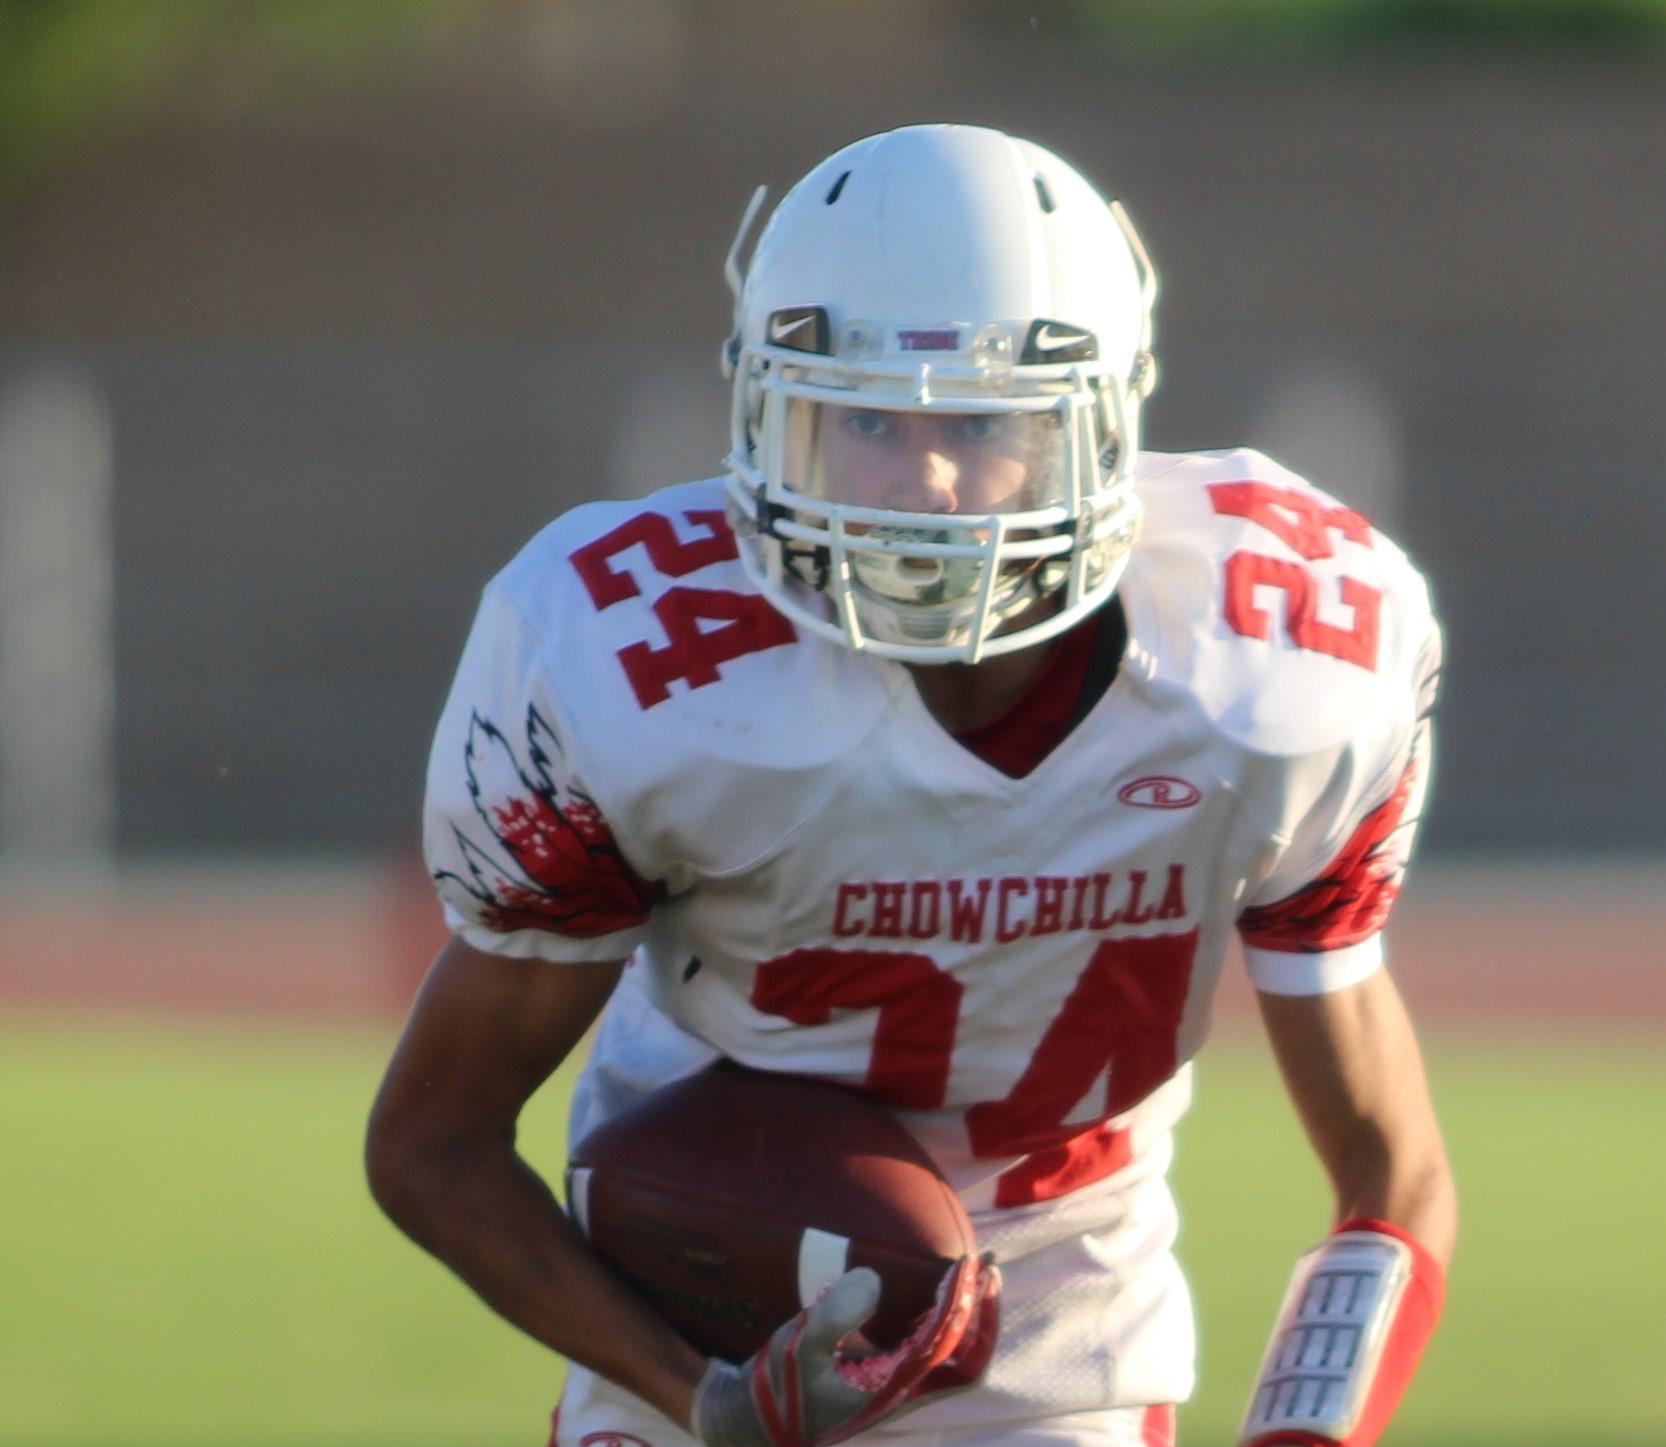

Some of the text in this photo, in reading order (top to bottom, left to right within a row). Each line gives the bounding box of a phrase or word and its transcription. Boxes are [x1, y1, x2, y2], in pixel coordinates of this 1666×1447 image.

[569, 511, 798, 710] 24
[1206, 480, 1381, 673] 24
[833, 863, 1186, 944] CHOWCHILLA
